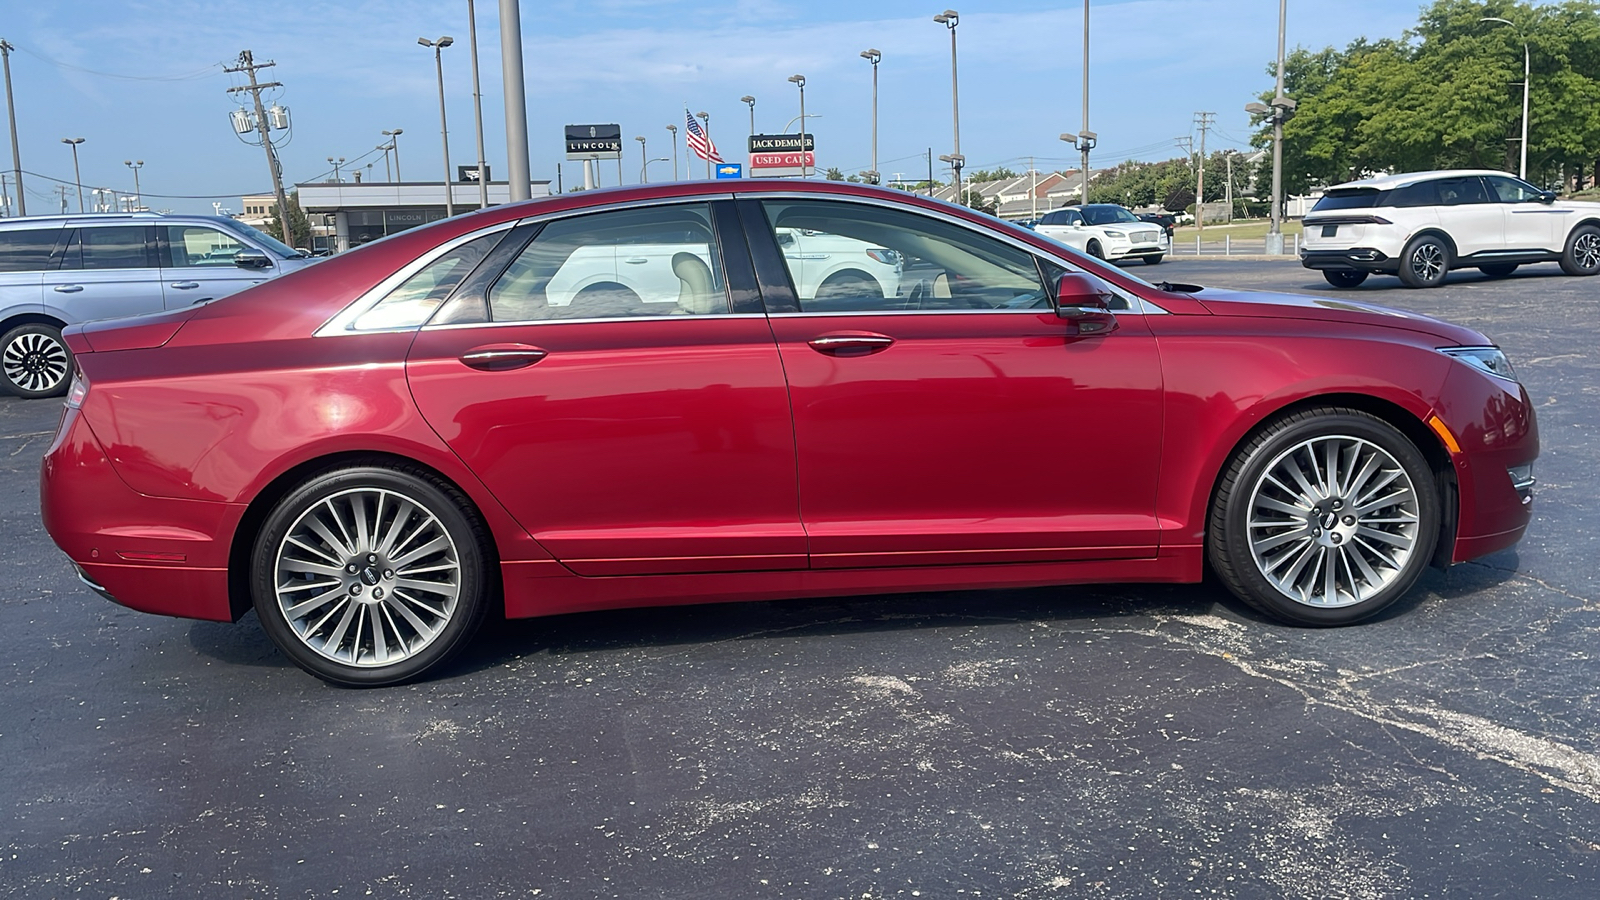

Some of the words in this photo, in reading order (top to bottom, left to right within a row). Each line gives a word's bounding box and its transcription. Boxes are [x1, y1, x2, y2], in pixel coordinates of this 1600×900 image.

[571, 142, 618, 150] LINCOLN
[752, 139, 774, 149] JACK
[755, 156, 782, 164] USED
